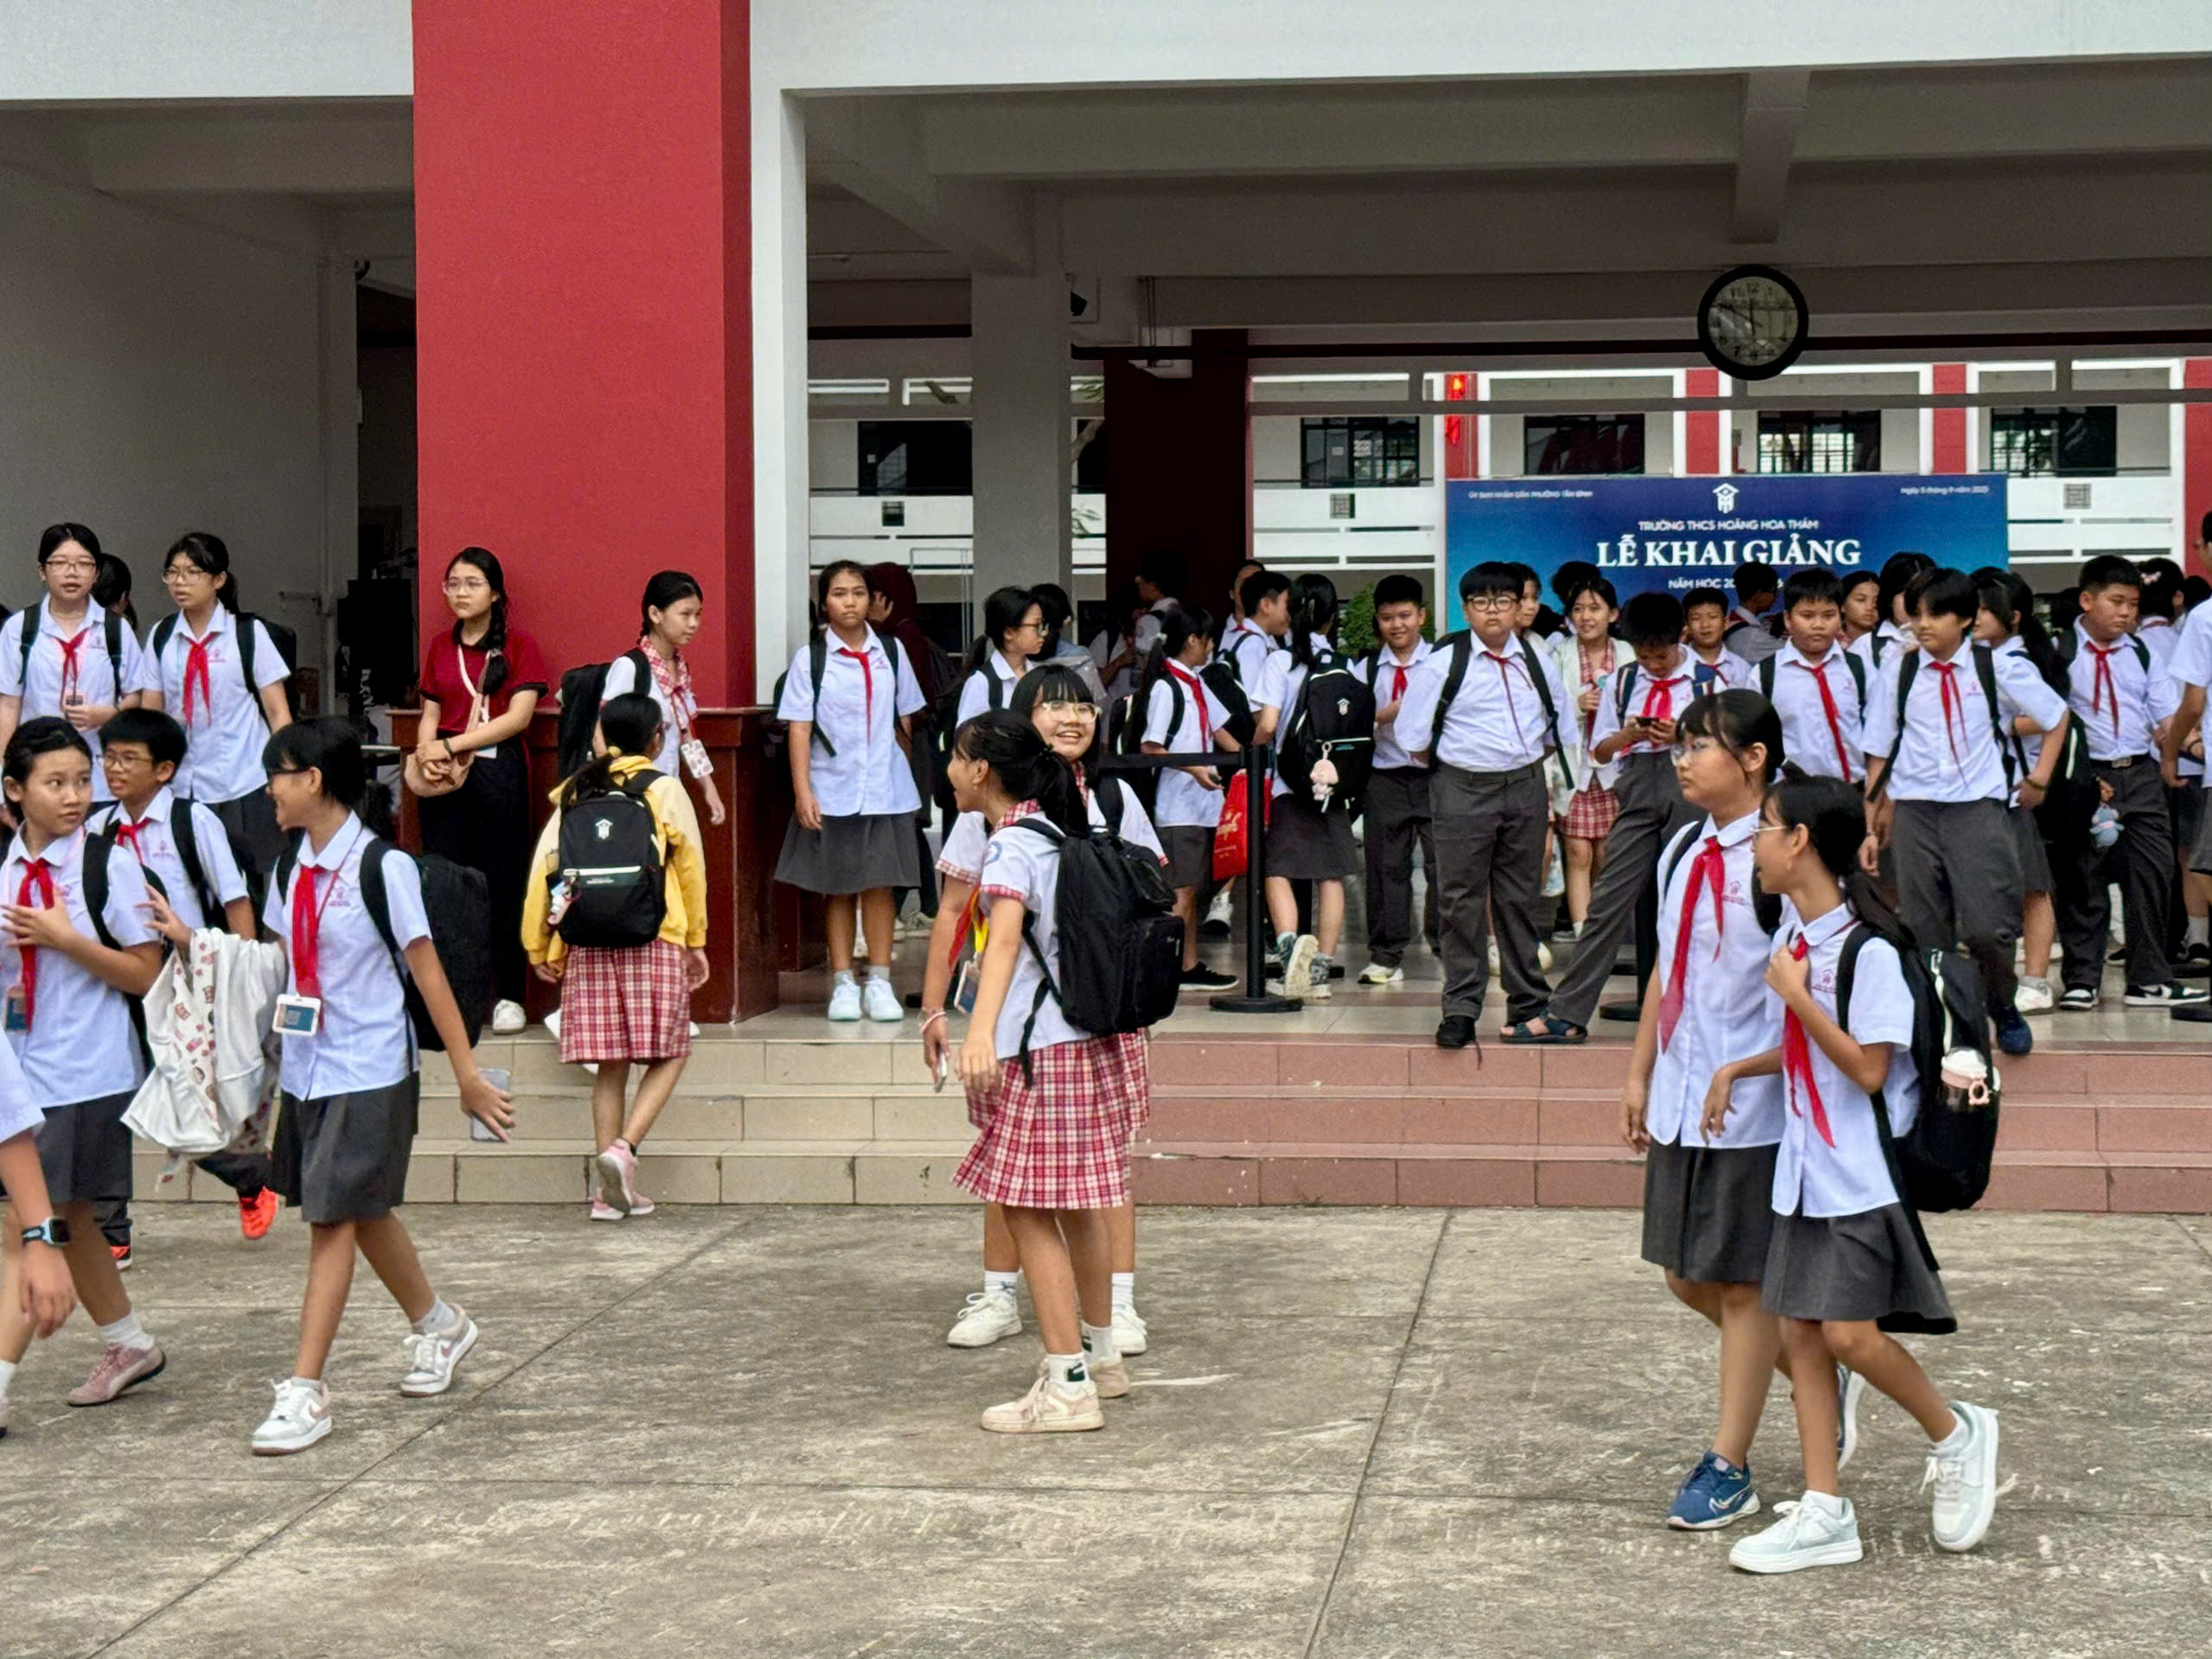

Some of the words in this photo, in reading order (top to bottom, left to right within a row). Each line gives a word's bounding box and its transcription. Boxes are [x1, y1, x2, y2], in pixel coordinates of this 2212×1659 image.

[1639, 519, 1685, 531] TRƯỜNG
[1687, 520, 1717, 530] THCS
[1761, 520, 1786, 530] HOA
[1595, 535, 1639, 567] LỄ
[1644, 541, 1736, 567] KHAI
[1742, 533, 1861, 566] GIẢNG
[1668, 577, 1694, 588] NĂM
